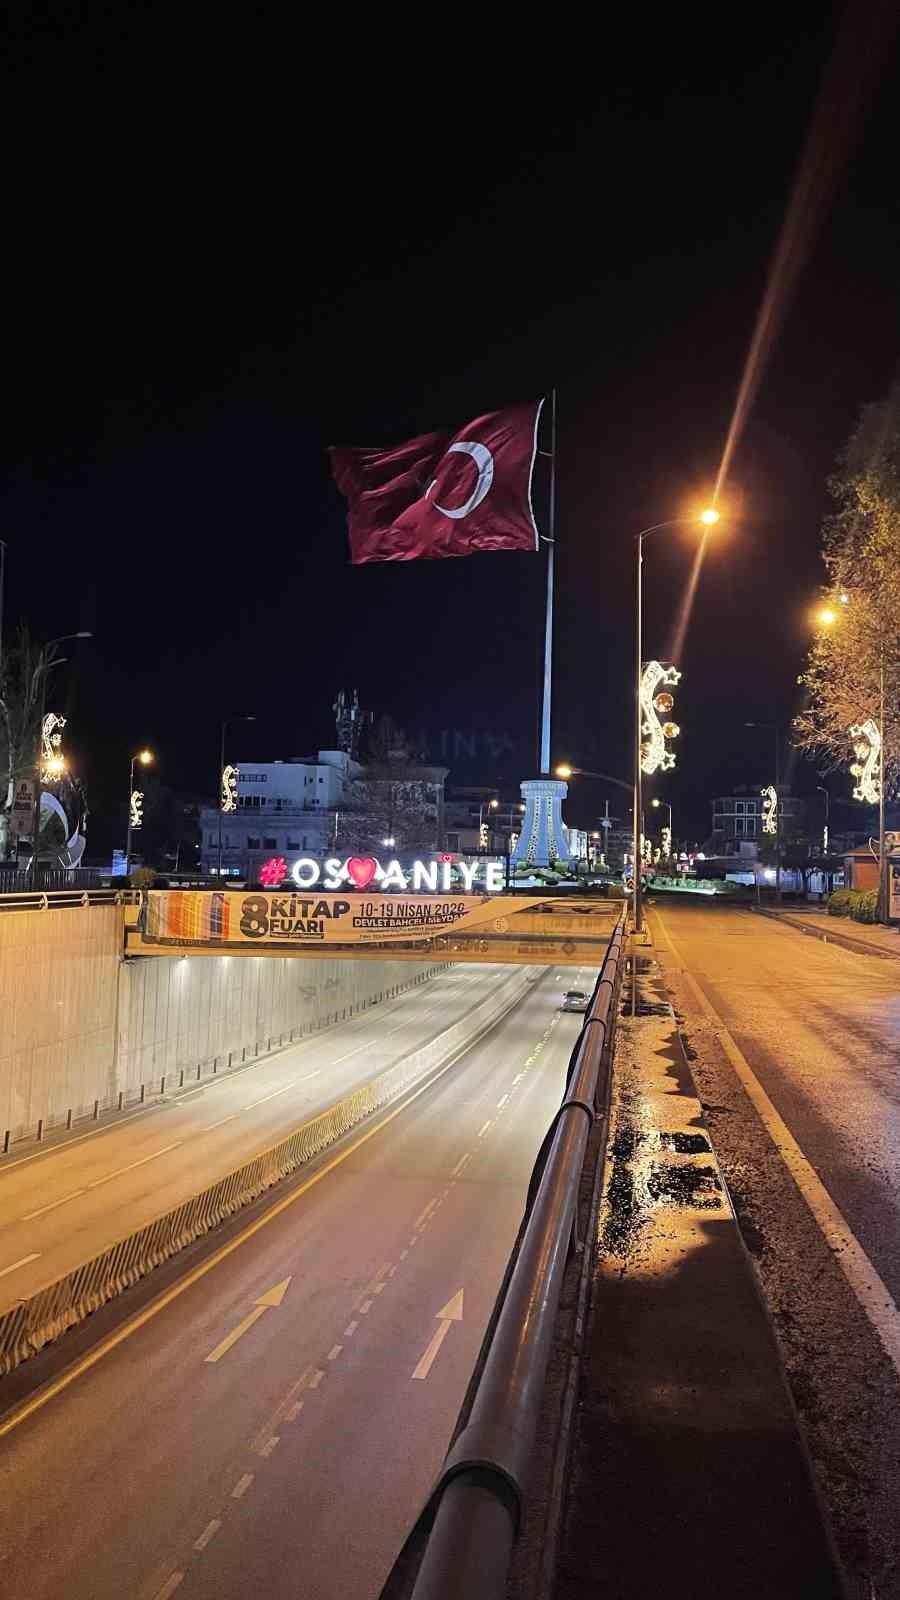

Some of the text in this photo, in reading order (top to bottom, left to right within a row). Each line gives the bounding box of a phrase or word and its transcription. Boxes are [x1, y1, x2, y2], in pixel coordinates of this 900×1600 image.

[271, 893, 351, 918] KİTAP
[359, 902, 393, 916] 10-19
[397, 901, 431, 917] NİSAN
[270, 919, 324, 932] FUARI
[354, 918, 389, 927] DEVLET
